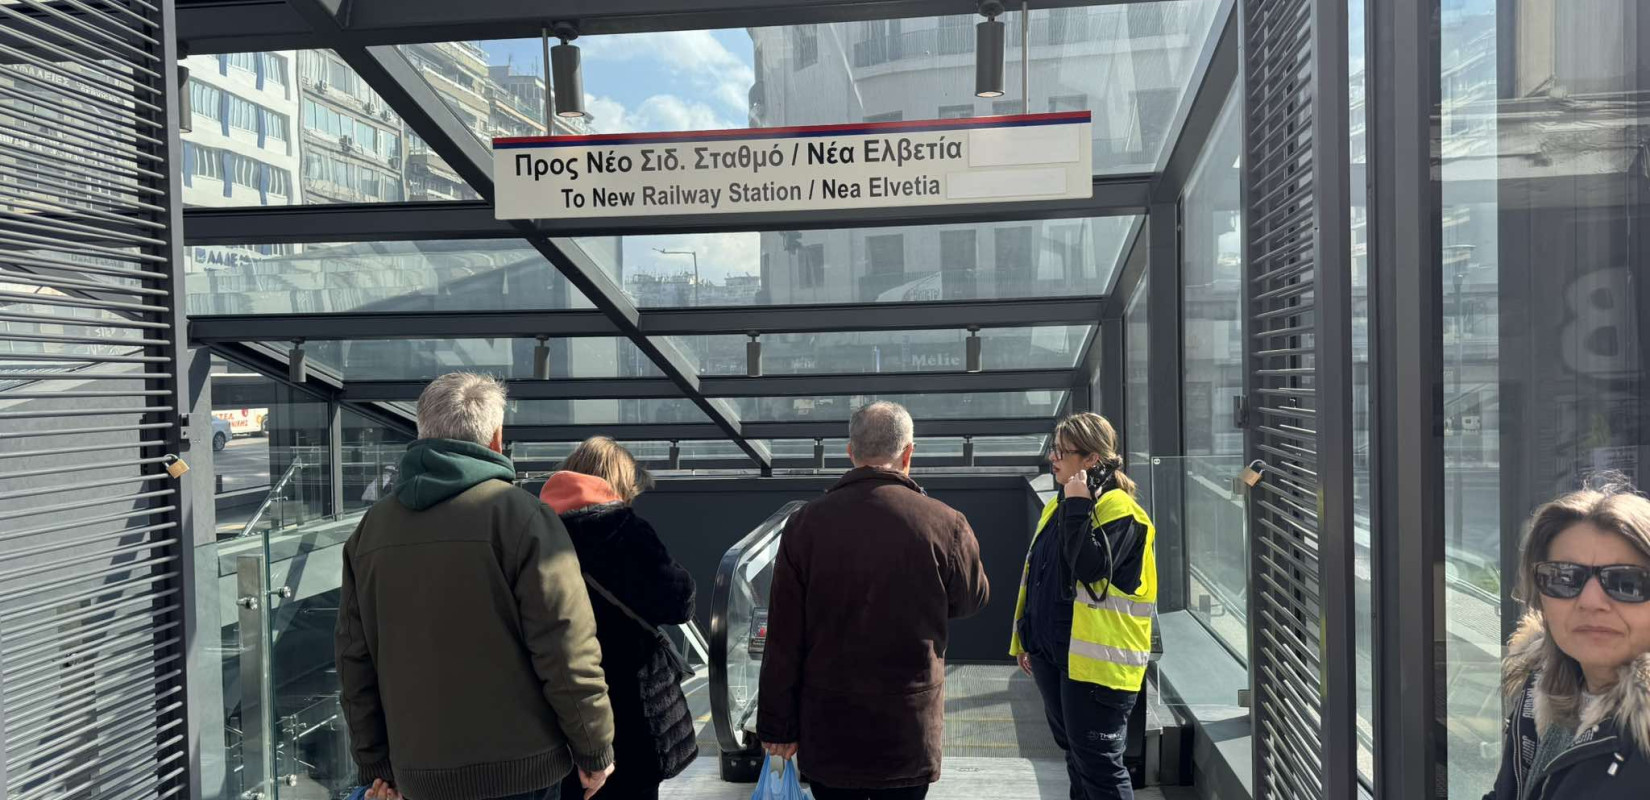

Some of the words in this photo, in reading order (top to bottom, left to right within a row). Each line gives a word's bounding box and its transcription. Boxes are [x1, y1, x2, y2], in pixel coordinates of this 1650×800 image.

[515, 153, 579, 181] Προς
[587, 149, 633, 175] Νέο
[640, 148, 685, 172] Σιδ.
[694, 143, 784, 173] Σταθμό
[791, 143, 800, 166] /
[807, 140, 855, 165] Νέα
[863, 136, 962, 167] Ελβετία
[561, 188, 585, 208] To
[592, 187, 635, 207] New
[642, 185, 721, 209] Railway
[729, 181, 802, 203] Station
[808, 179, 815, 200] /
[822, 178, 862, 199] Nea
[868, 175, 940, 197] Elvetia
